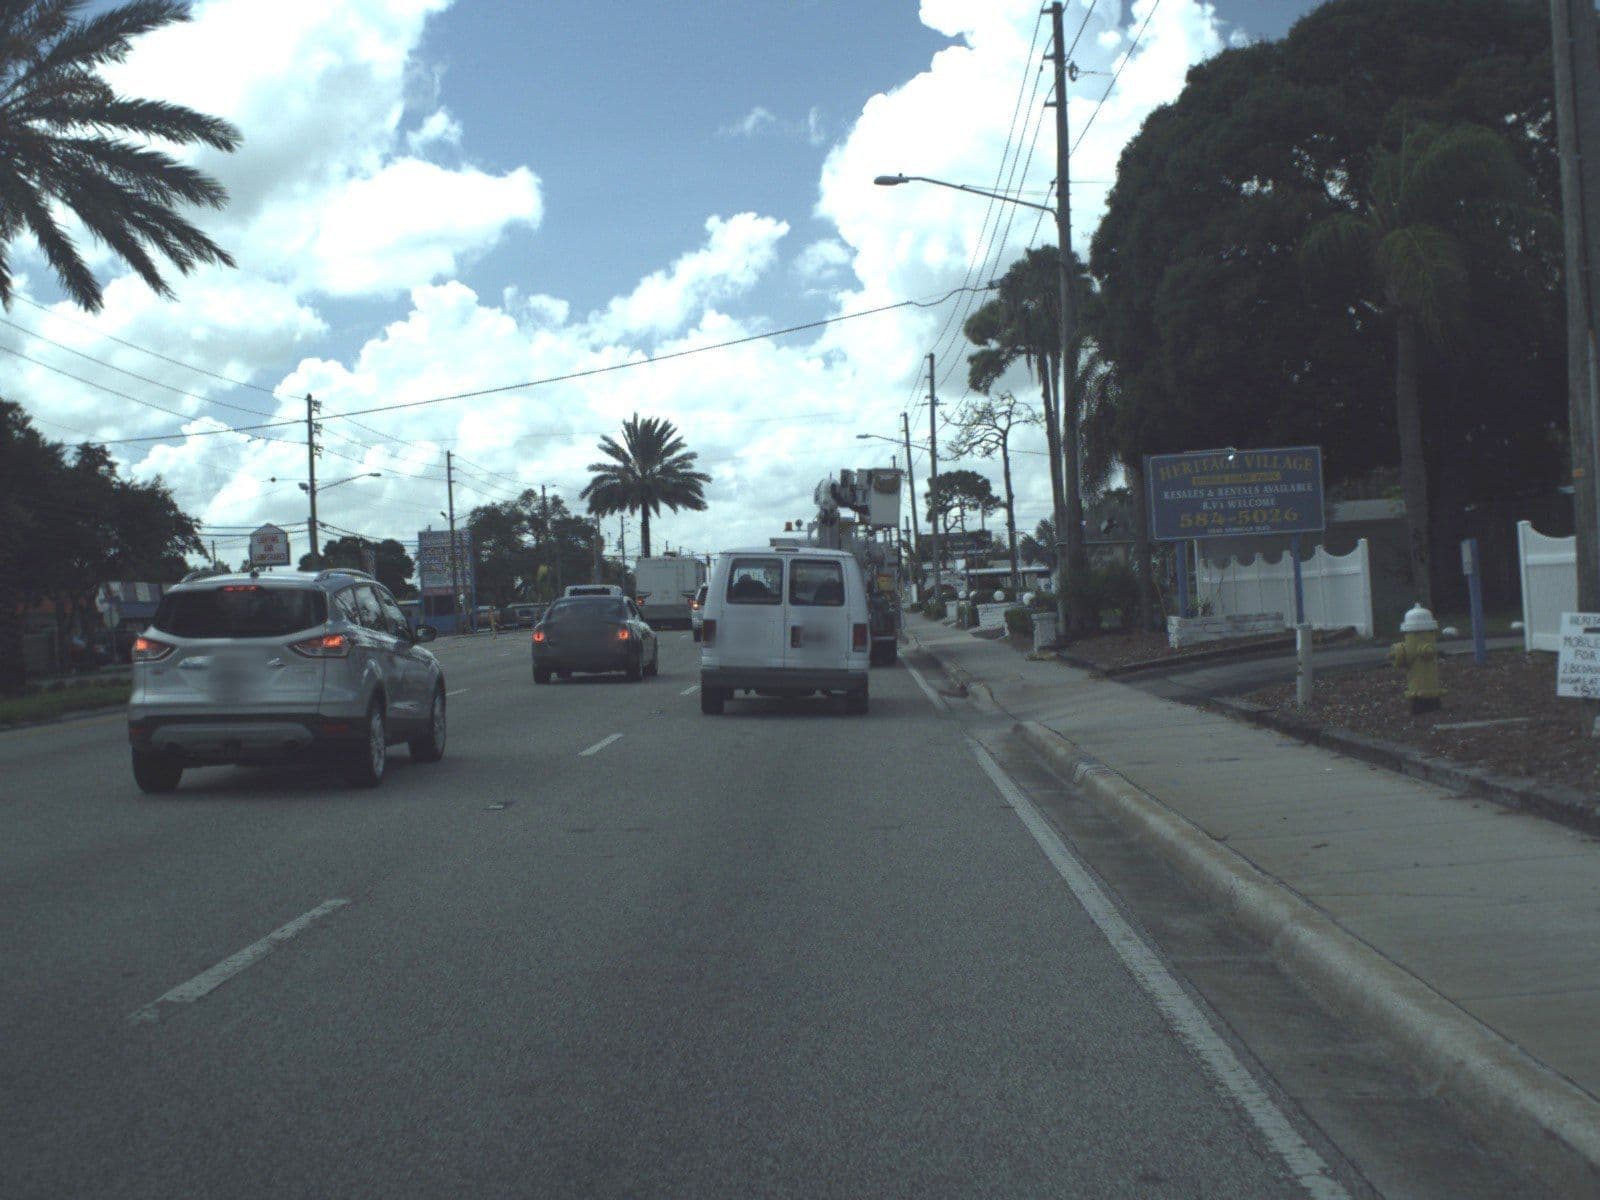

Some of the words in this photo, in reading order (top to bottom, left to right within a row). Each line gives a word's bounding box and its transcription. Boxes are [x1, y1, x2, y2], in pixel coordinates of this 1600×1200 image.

[1160, 456, 1240, 480] HERITAGE
[1245, 455, 1313, 472] VILLAGE
[1163, 488, 1206, 500] RESALES
[1207, 489, 1215, 497] &
[1217, 486, 1260, 497] RENTALS
[1264, 482, 1313, 494] AVAILABLE
[1228, 499, 1277, 509] WELCOME
[1179, 506, 1300, 528] 584-5026
